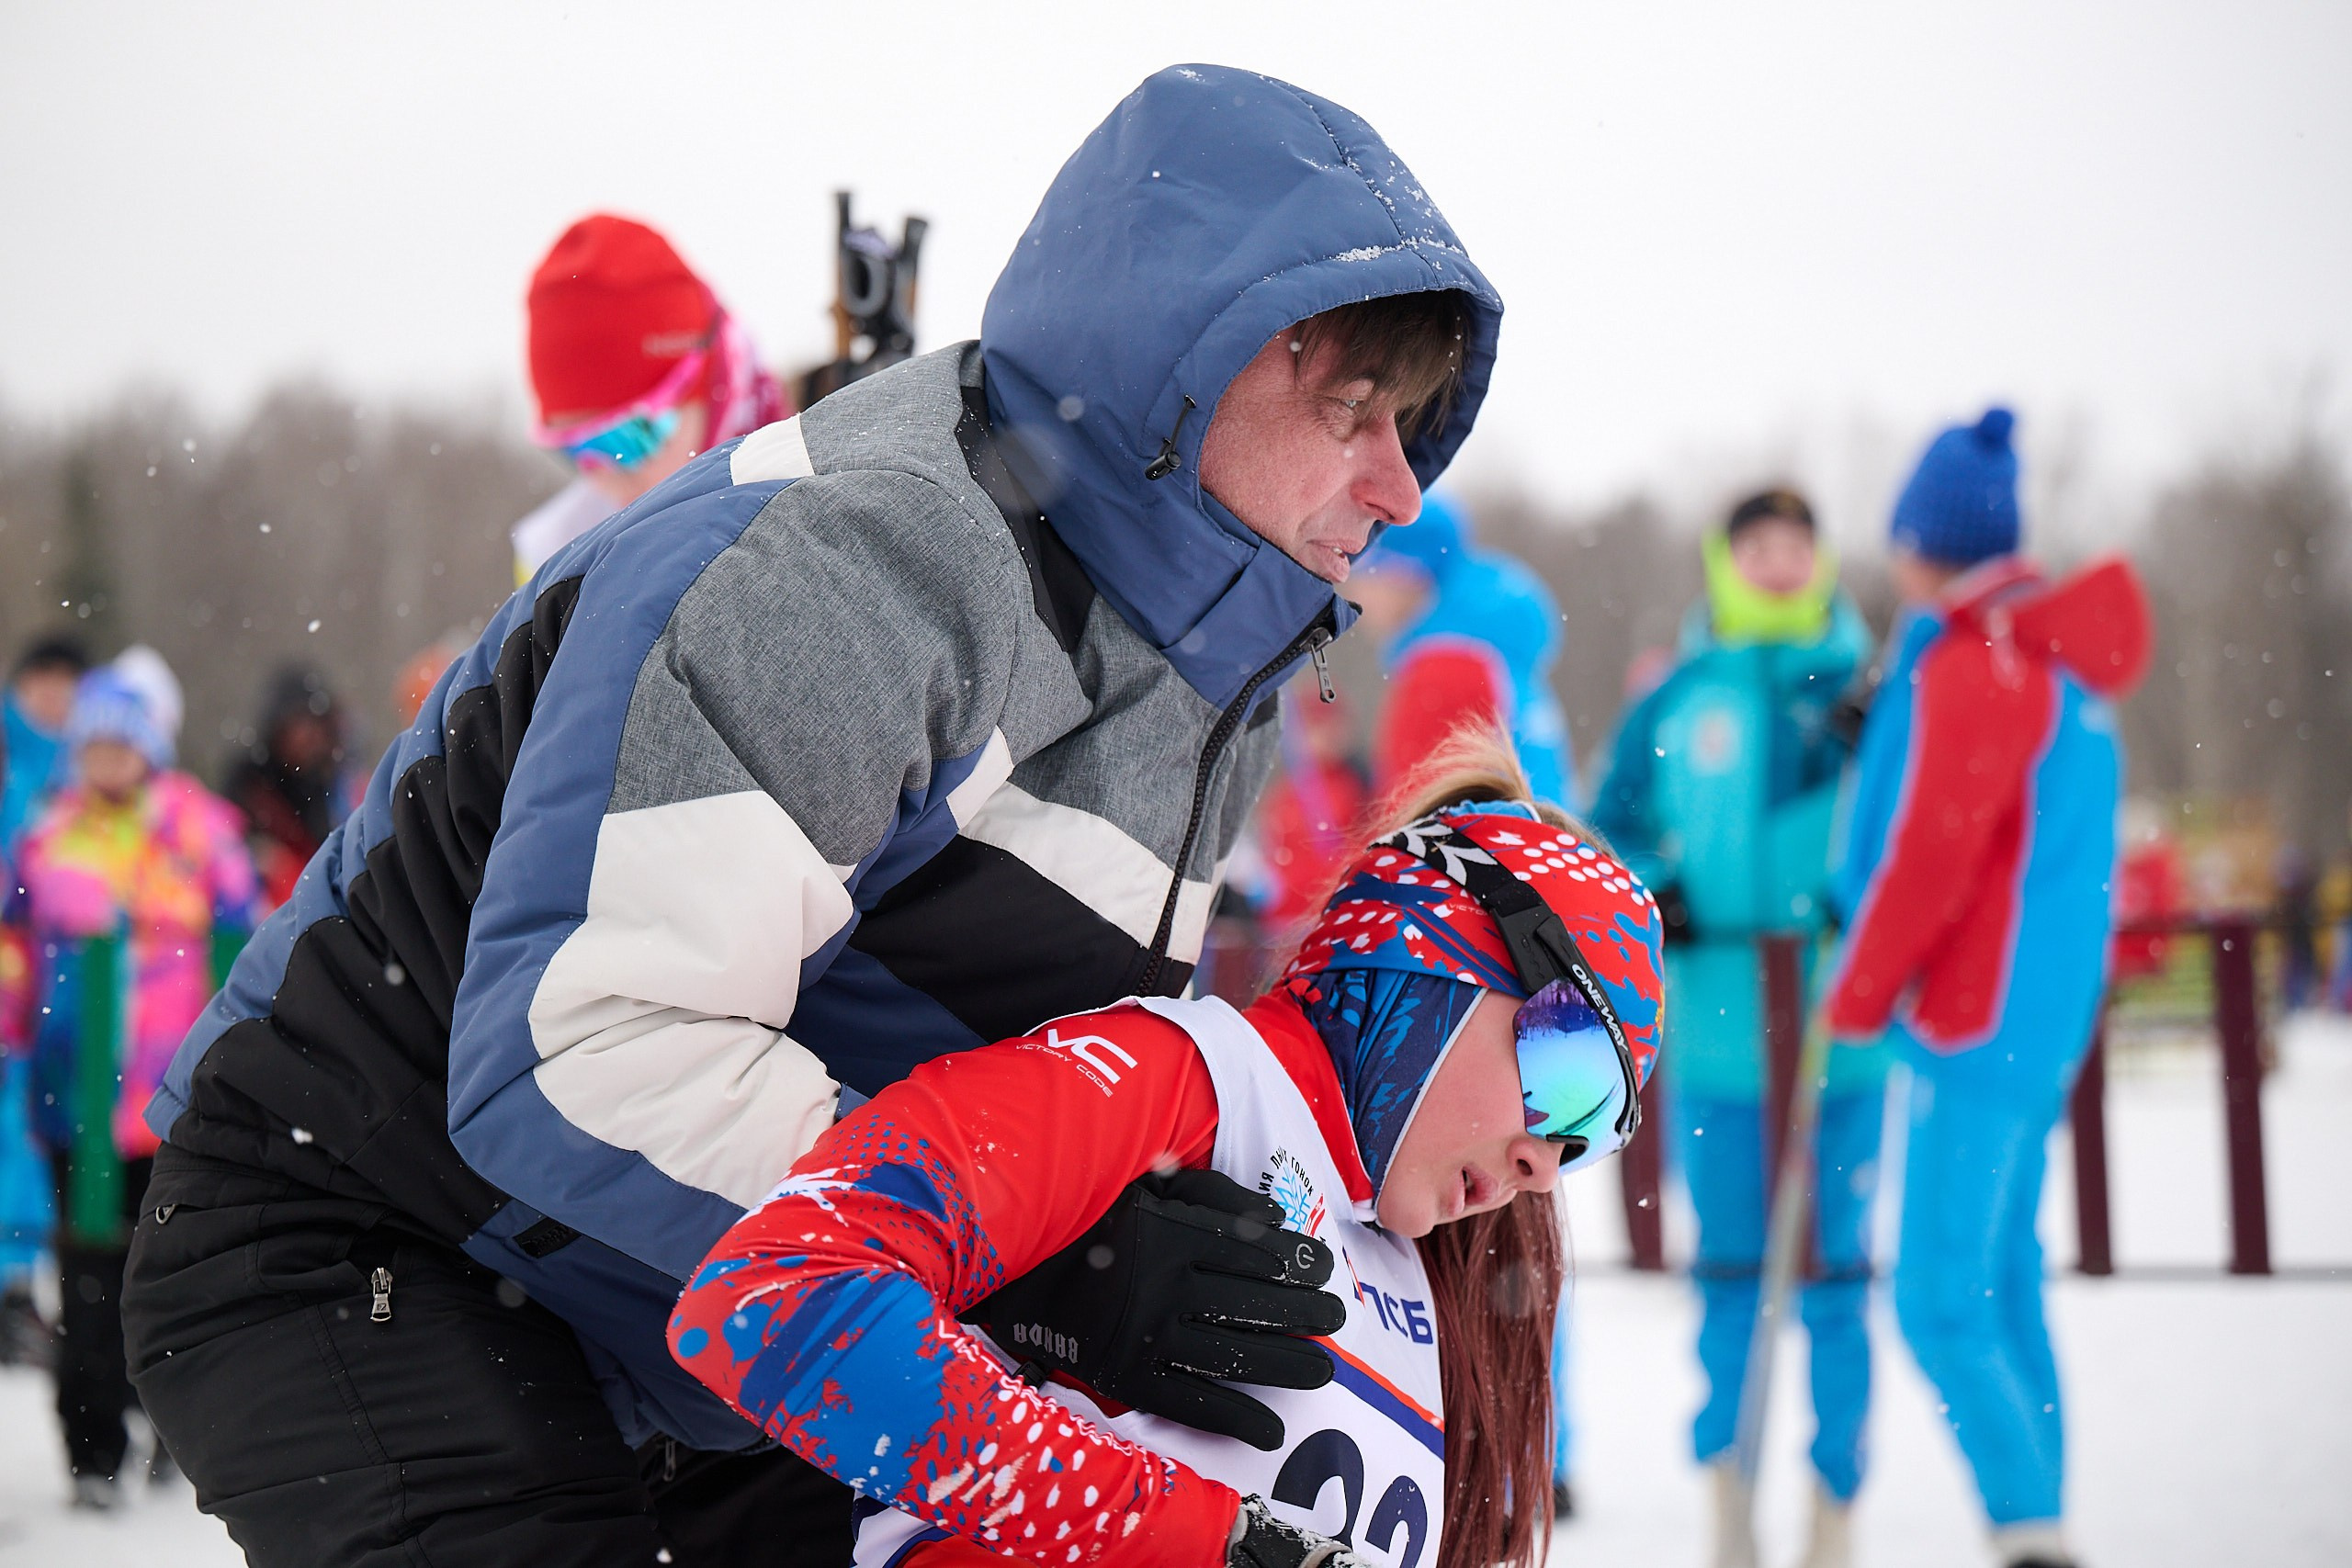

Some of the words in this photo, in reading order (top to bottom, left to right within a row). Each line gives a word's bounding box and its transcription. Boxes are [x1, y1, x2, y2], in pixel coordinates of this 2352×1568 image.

[1571, 964, 1629, 1052] ONEWAY
[1015, 1043, 1072, 1063] VICTORY
[1076, 1064, 1114, 1098] CODE
